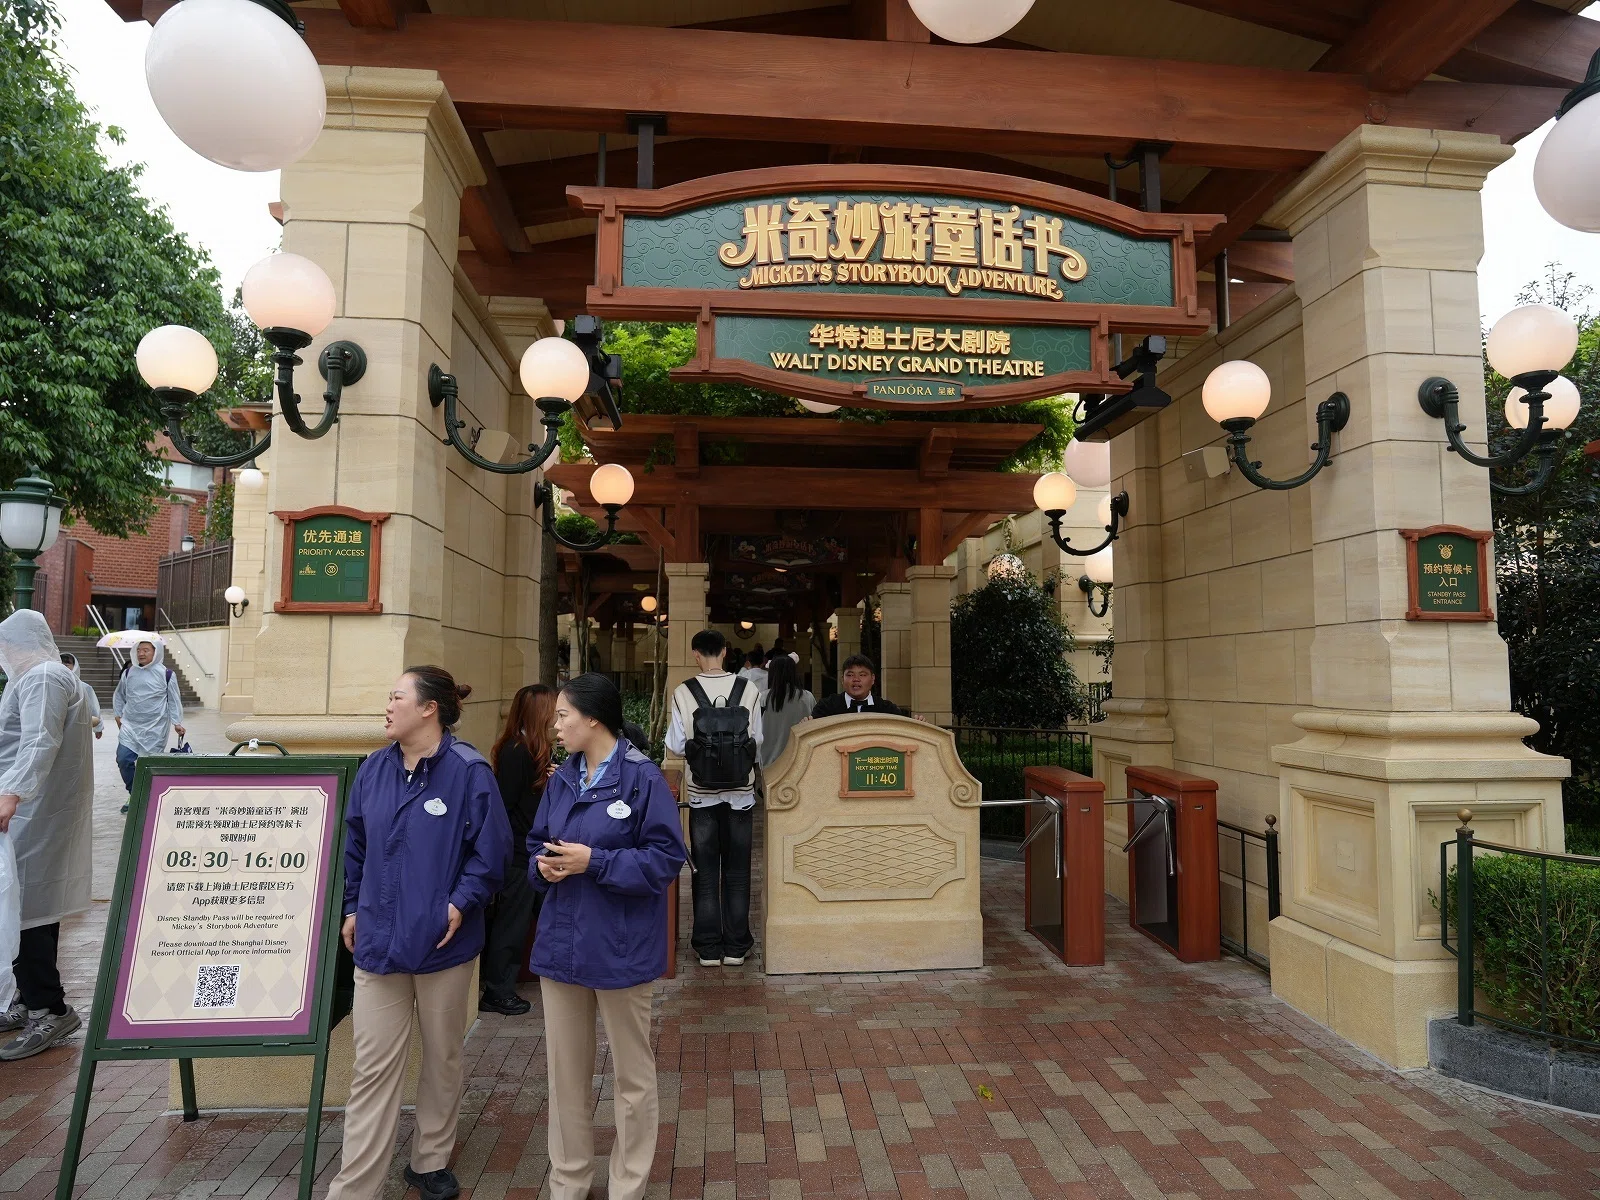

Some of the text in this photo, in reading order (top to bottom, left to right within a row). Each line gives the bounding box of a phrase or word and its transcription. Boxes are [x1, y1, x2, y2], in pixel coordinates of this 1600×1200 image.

[719, 197, 1088, 281] 米奇妙游童话书
[739, 263, 1064, 301] MICKEY'S STORYBOOK ADVENTURE
[809, 323, 1011, 355] 华特迪士尼大剧院
[770, 352, 1045, 377] WALT DISNEY GRAND THEATRE
[938, 387, 956, 396] 呈献
[303, 530, 362, 544] 优先通道
[335, 549, 365, 557] ACCESS
[1423, 564, 1472, 575] 预约等候卡
[1439, 577, 1458, 587] 入口
[866, 773, 896, 785] 11:40
[220, 834, 256, 842] 领取时间
[183, 914, 211, 922] Standby
[207, 923, 241, 931] Storybook
[231, 939, 263, 947] Shanghai
[265, 939, 288, 947] Disney
